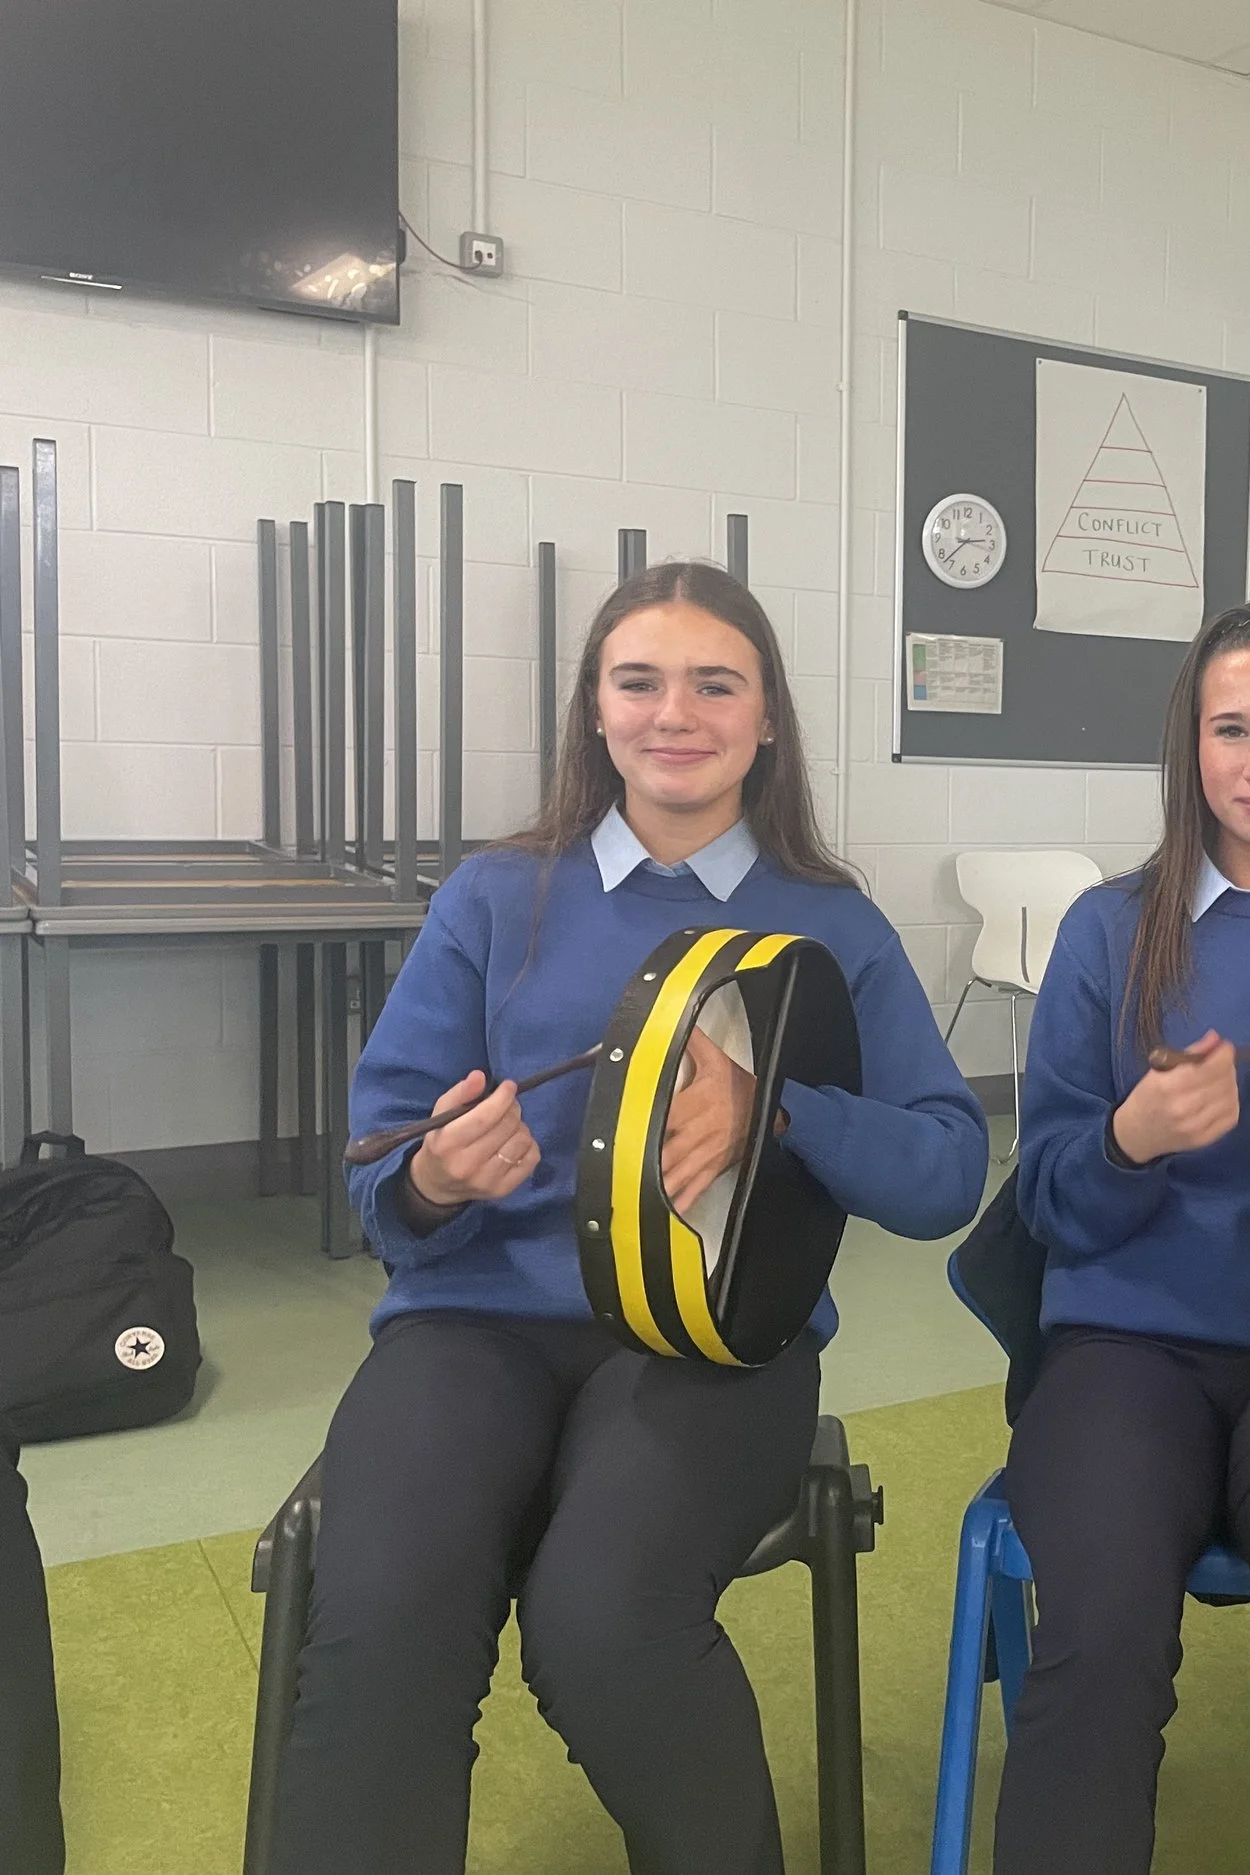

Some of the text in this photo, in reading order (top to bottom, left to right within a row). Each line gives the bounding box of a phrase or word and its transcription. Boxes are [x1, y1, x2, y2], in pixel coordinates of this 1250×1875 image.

[952, 509, 960, 520] 11
[963, 507, 973, 519] 12
[941, 518, 951, 530] 10
[1078, 512, 1162, 537] CONFLICT
[985, 525, 993, 536] 2
[935, 533, 941, 543] 9
[988, 540, 996, 551] 3
[938, 549, 945, 559] 8
[949, 560, 955, 570] 7
[984, 555, 990, 565] 4
[1082, 549, 1151, 572] TRUST
[960, 565, 967, 576] 6
[973, 563, 980, 574] 5
